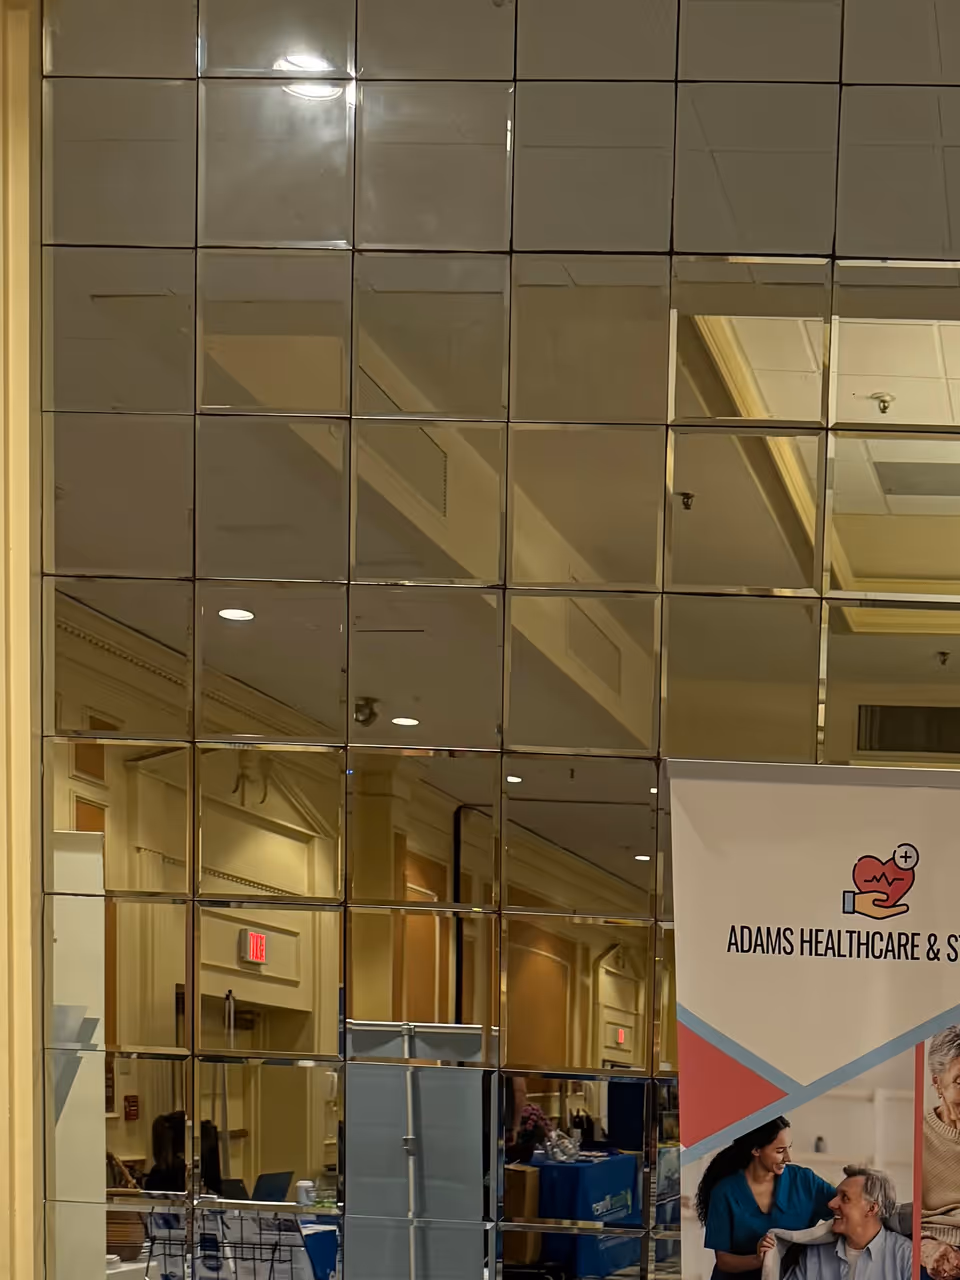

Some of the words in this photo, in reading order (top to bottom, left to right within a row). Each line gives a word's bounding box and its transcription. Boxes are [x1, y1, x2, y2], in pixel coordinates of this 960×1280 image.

[726, 924, 794, 956] ADAMS
[799, 928, 921, 961] HEALTHCARE
[925, 933, 942, 962] &
